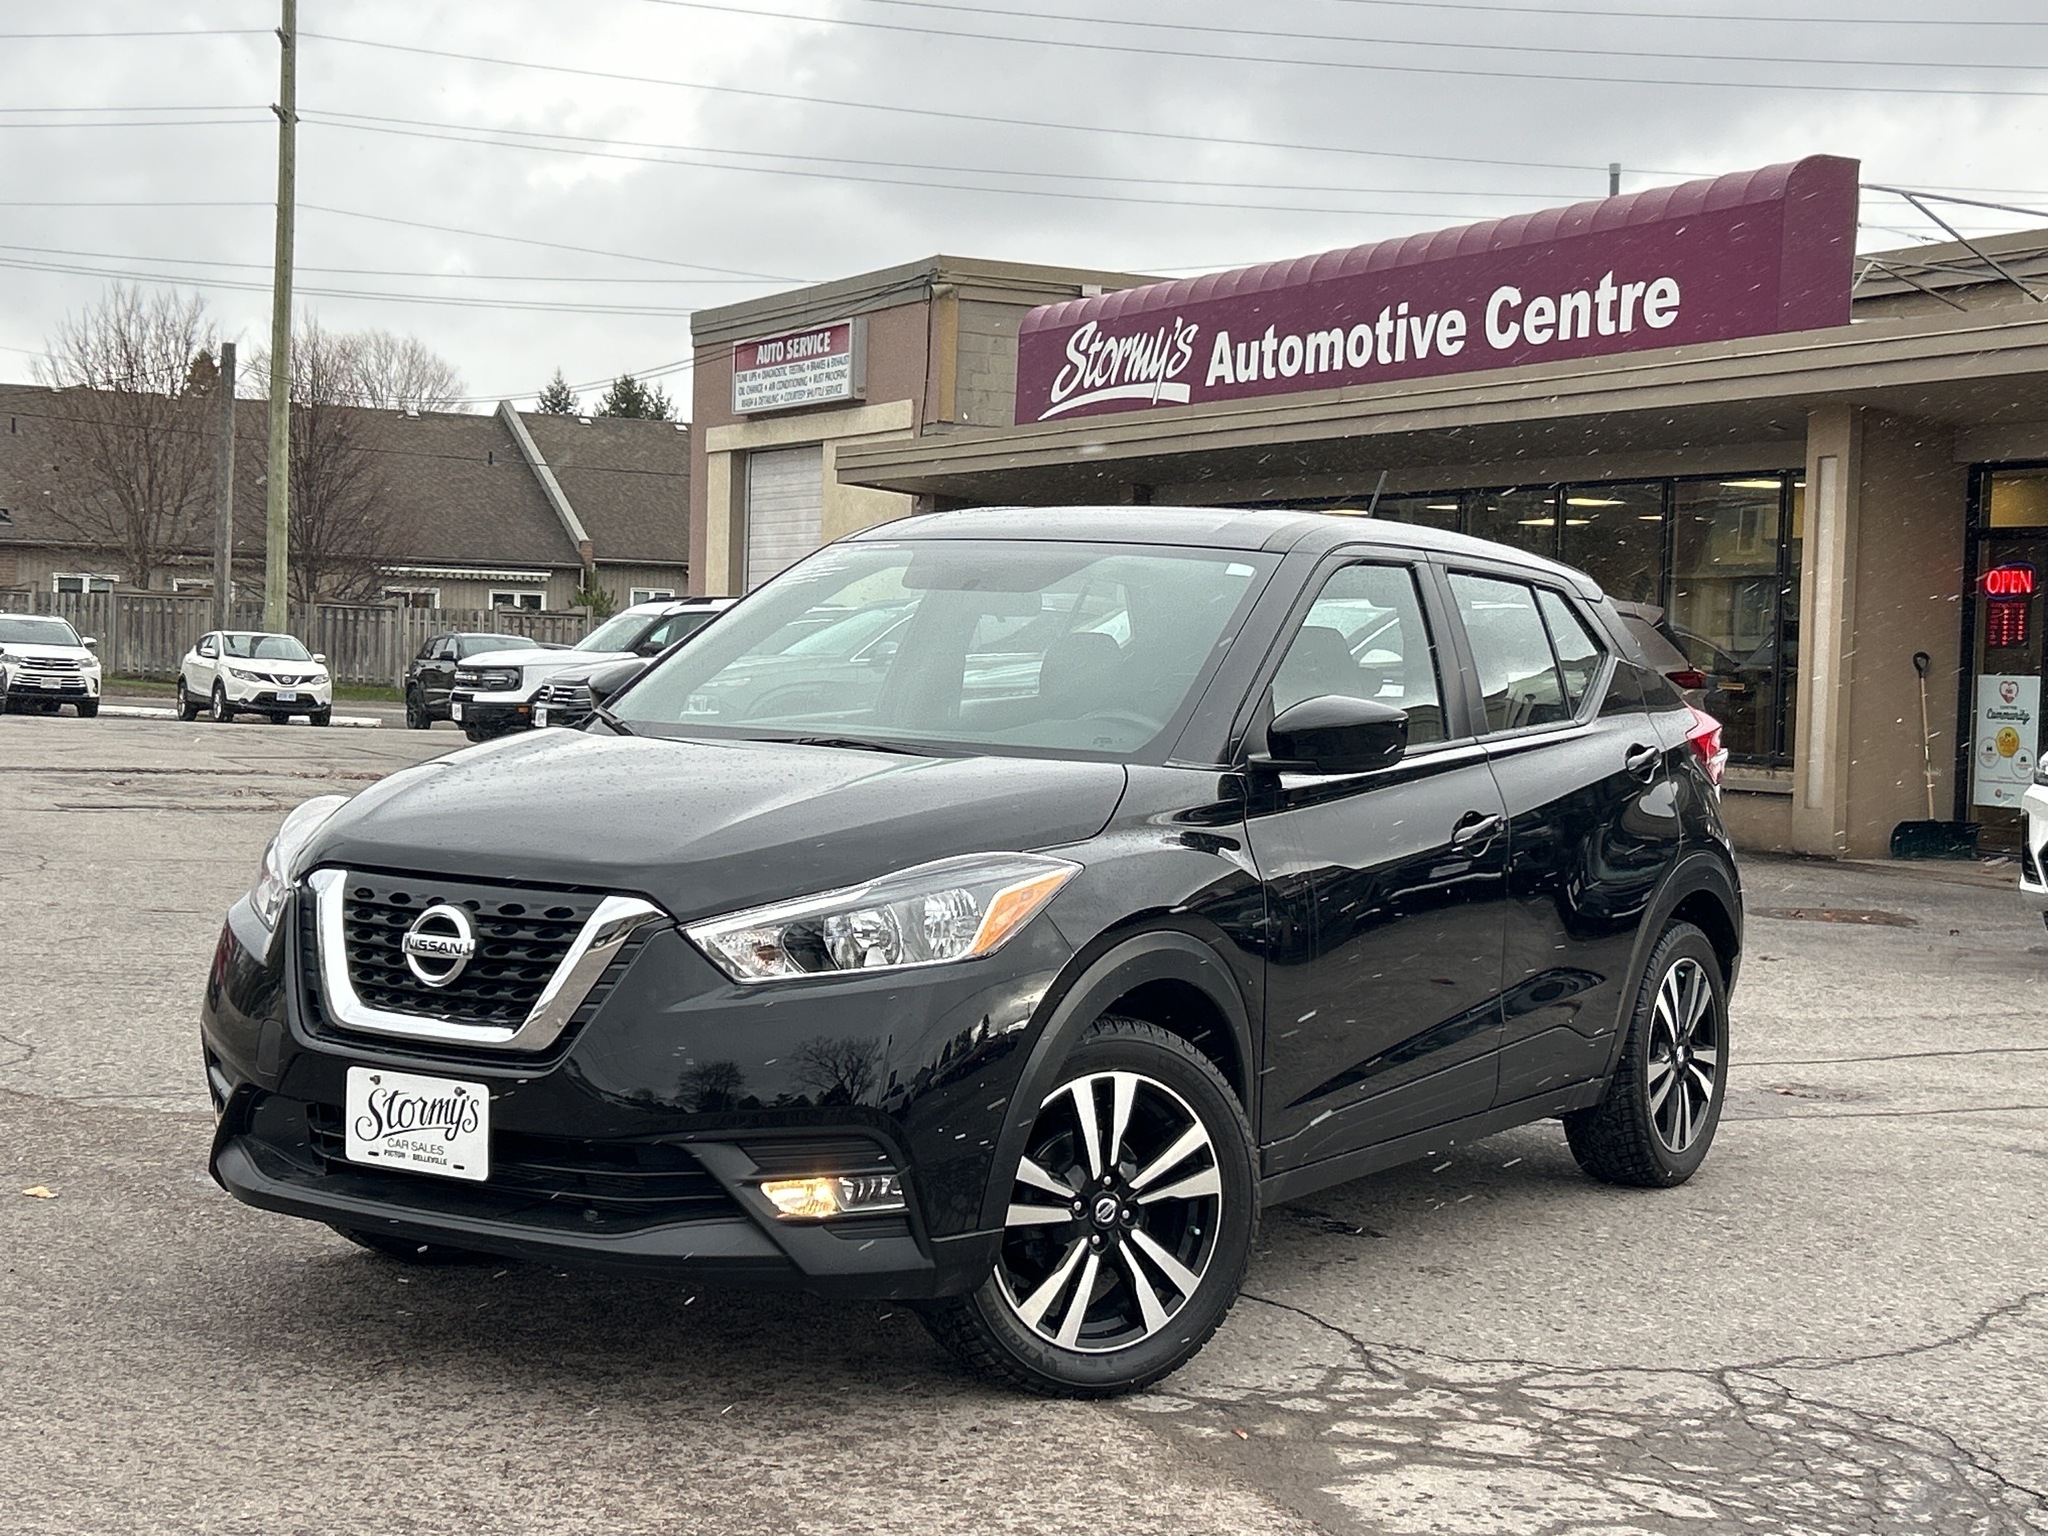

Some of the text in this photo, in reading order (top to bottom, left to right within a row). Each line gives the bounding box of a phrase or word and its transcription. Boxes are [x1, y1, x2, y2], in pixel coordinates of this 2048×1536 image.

[756, 331, 831, 365] AUTO SERVICE
[1051, 270, 1681, 405] Stormy's Automotive Centre
[1987, 570, 2032, 593] OPEN
[405, 937, 463, 955] NISSAN
[355, 1087, 480, 1141] Stormy's
[387, 1137, 444, 1156] CAR SALES
[412, 1153, 447, 1166] BELLEVILLE
